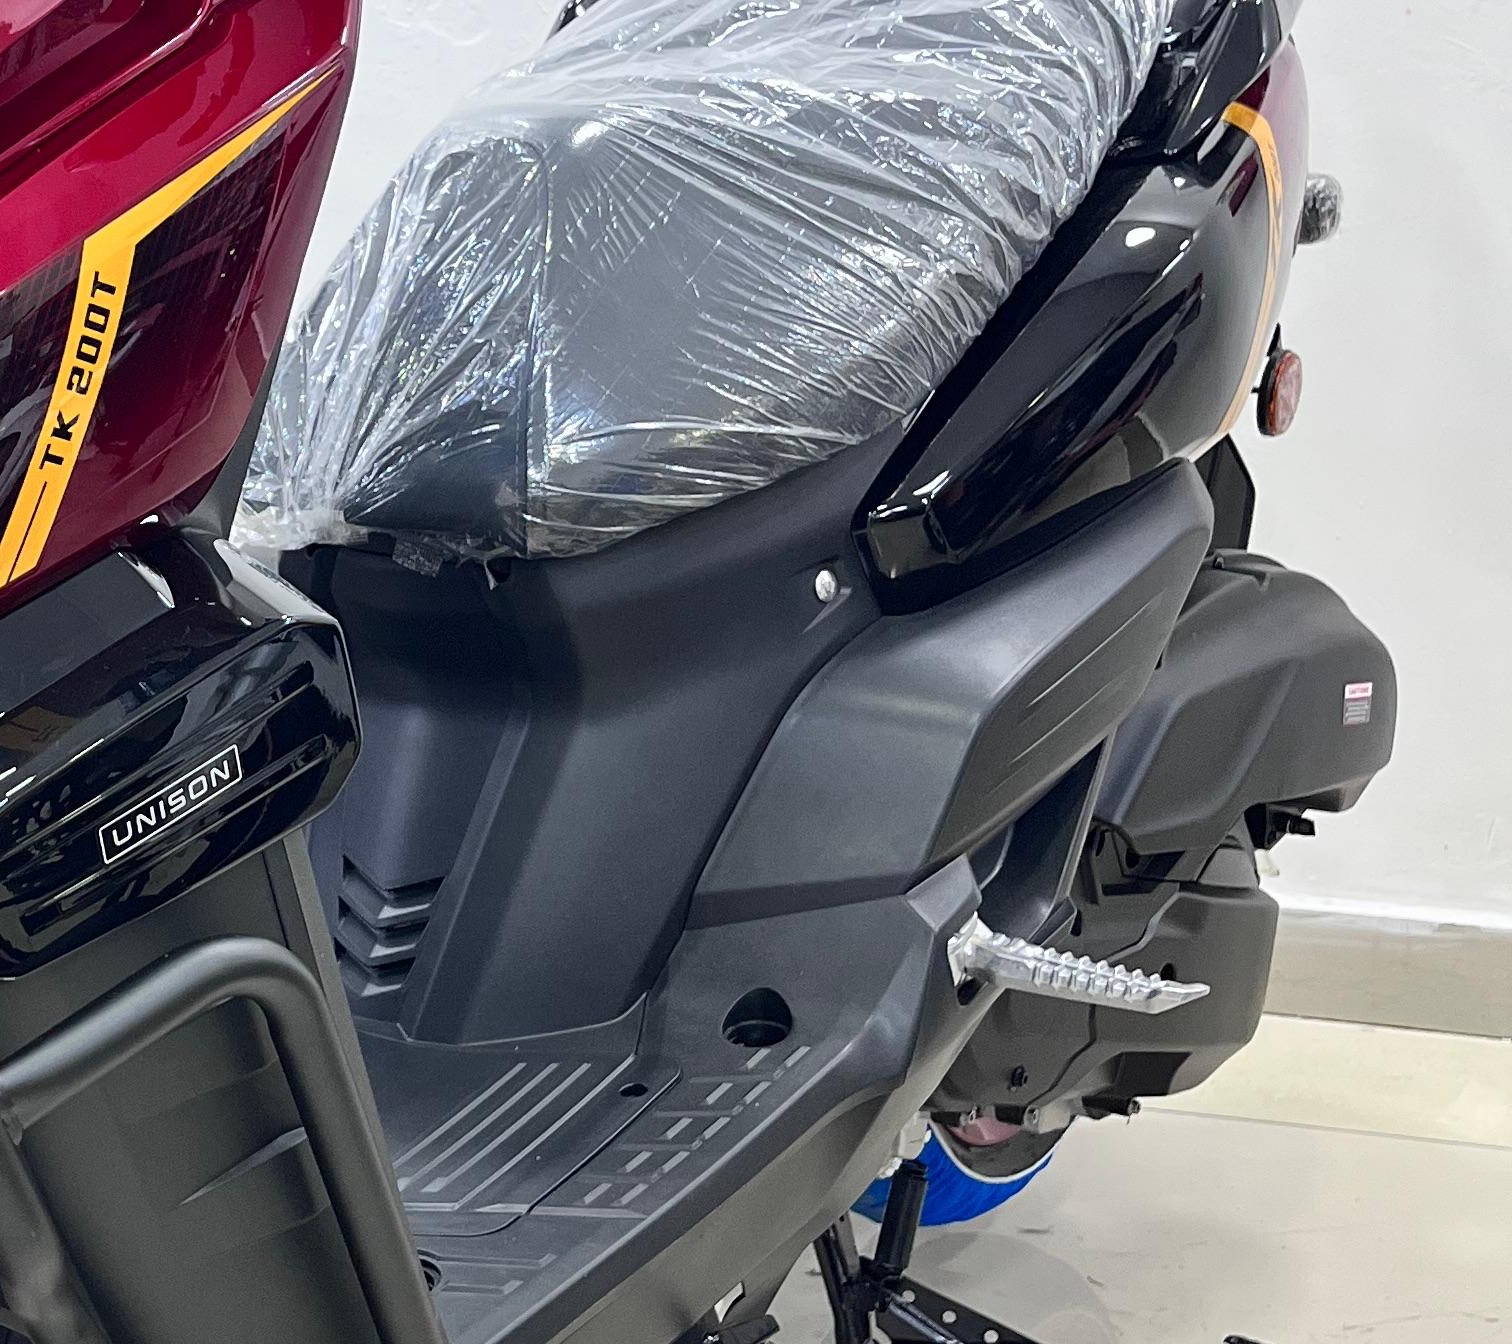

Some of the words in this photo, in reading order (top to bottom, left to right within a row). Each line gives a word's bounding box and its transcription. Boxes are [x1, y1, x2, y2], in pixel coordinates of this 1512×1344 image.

[39, 410, 81, 470] TK
[67, 271, 116, 395] 200T
[112, 759, 231, 846] UNISON
